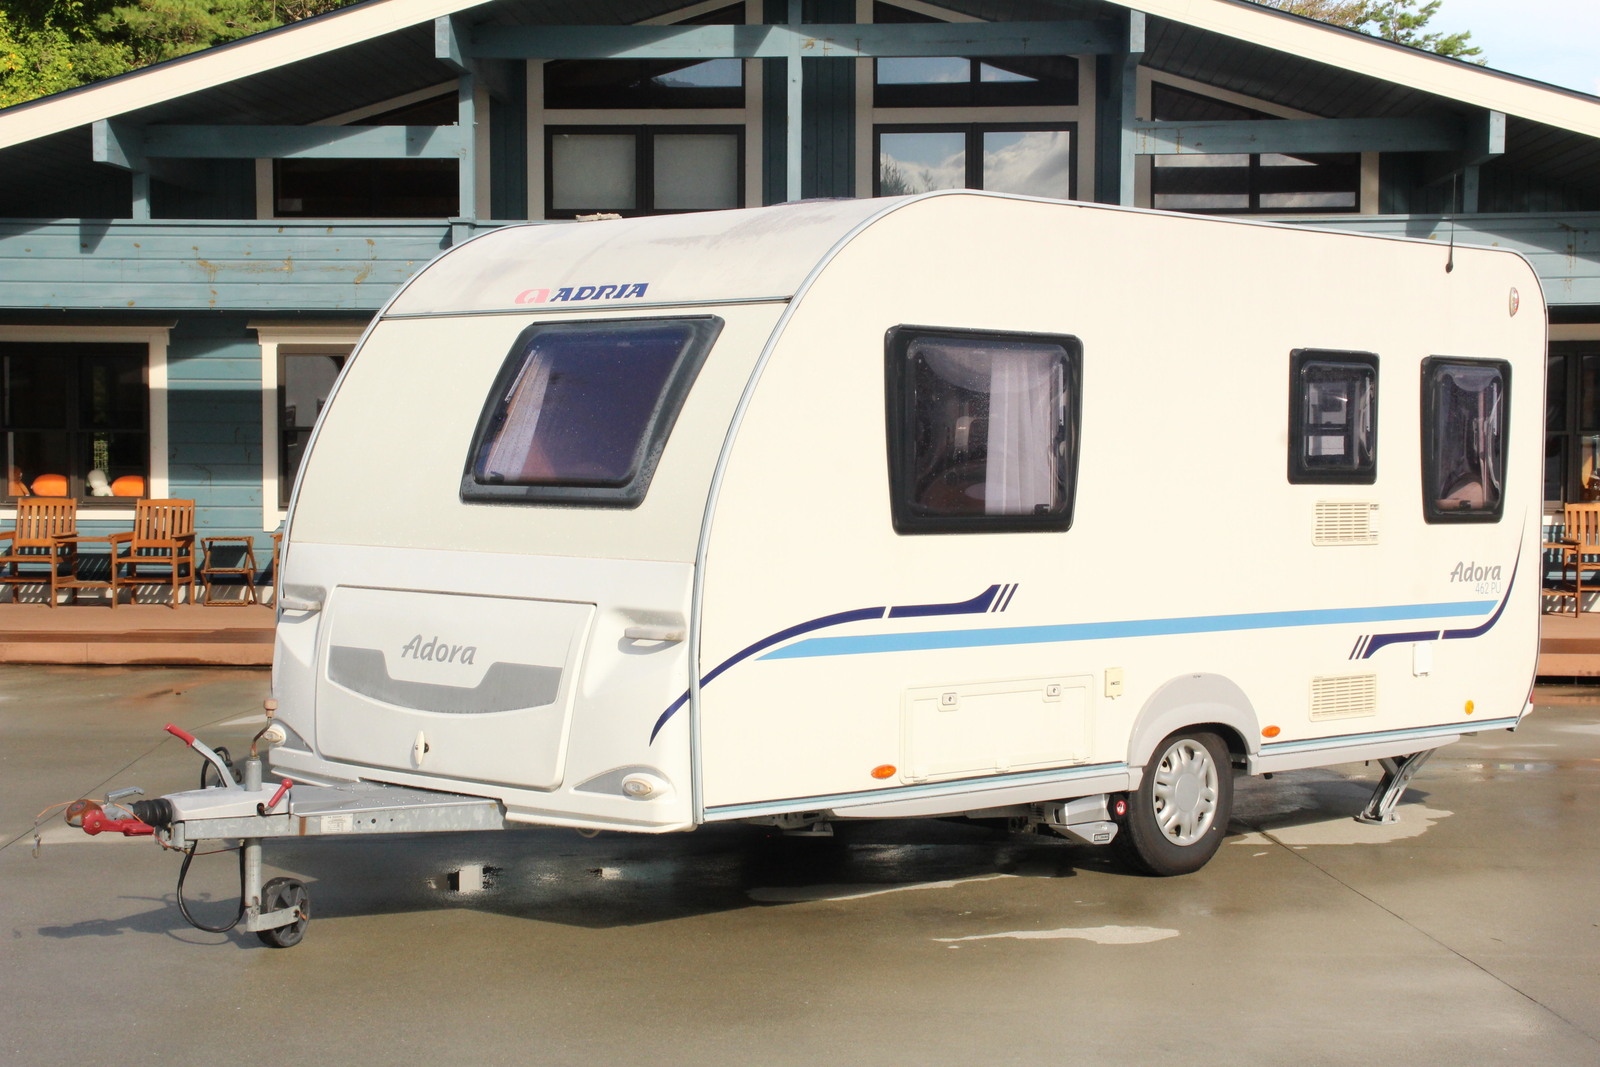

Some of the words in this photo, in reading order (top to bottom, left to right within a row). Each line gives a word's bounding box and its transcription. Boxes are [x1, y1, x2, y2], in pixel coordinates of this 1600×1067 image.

[549, 282, 649, 303] ADRIA
[1450, 561, 1502, 583] Adora
[1475, 582, 1489, 595] 462
[1490, 581, 1502, 594] PU
[400, 633, 478, 665] Adora
